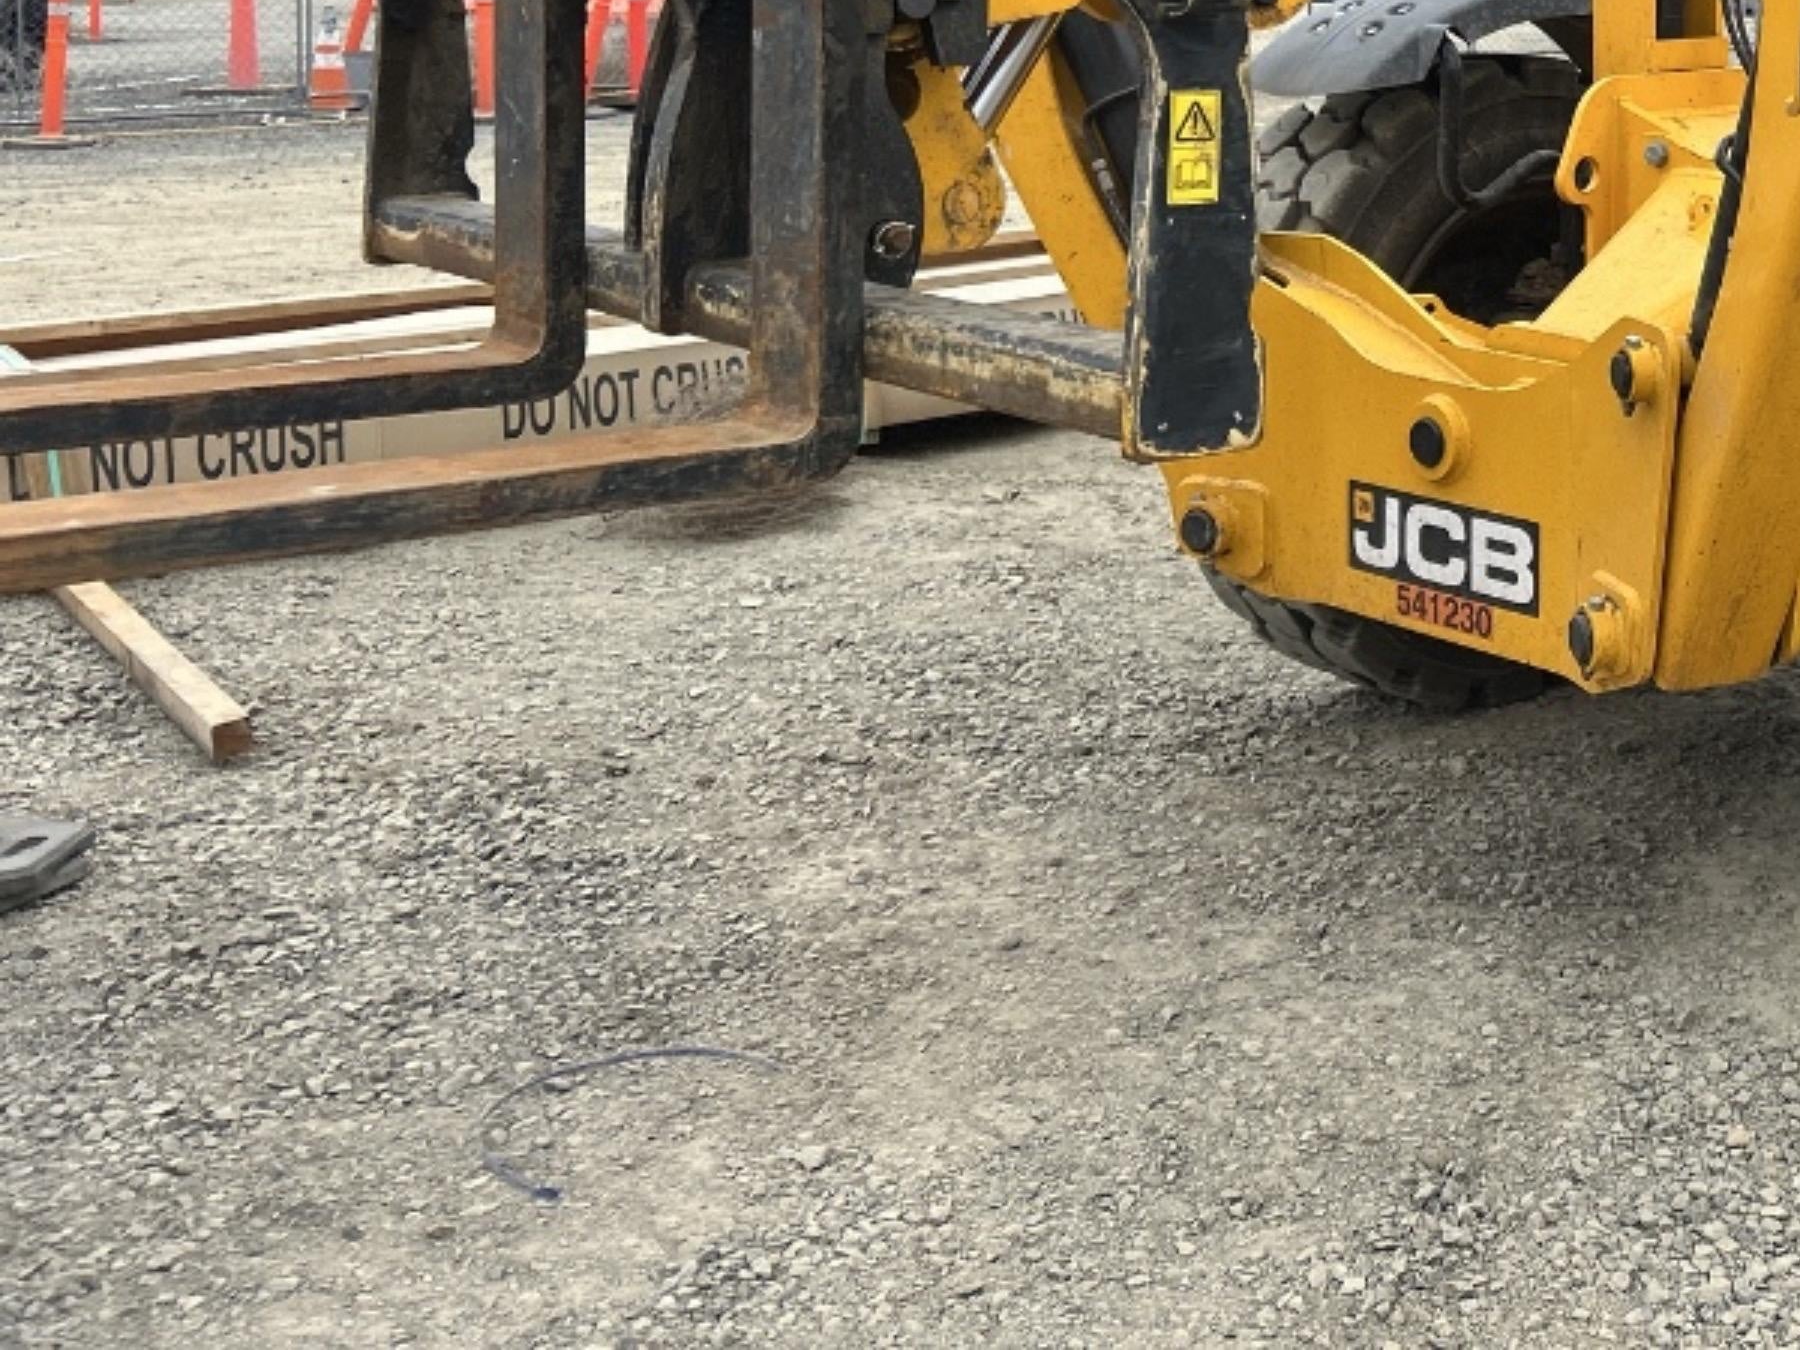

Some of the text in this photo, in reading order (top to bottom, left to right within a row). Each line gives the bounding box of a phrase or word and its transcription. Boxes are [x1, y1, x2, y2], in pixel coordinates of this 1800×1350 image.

[568, 369, 640, 431] NOT
[198, 417, 346, 480] CRUSH
[1353, 496, 1535, 605] JCB
[1396, 582, 1493, 639] 541230
